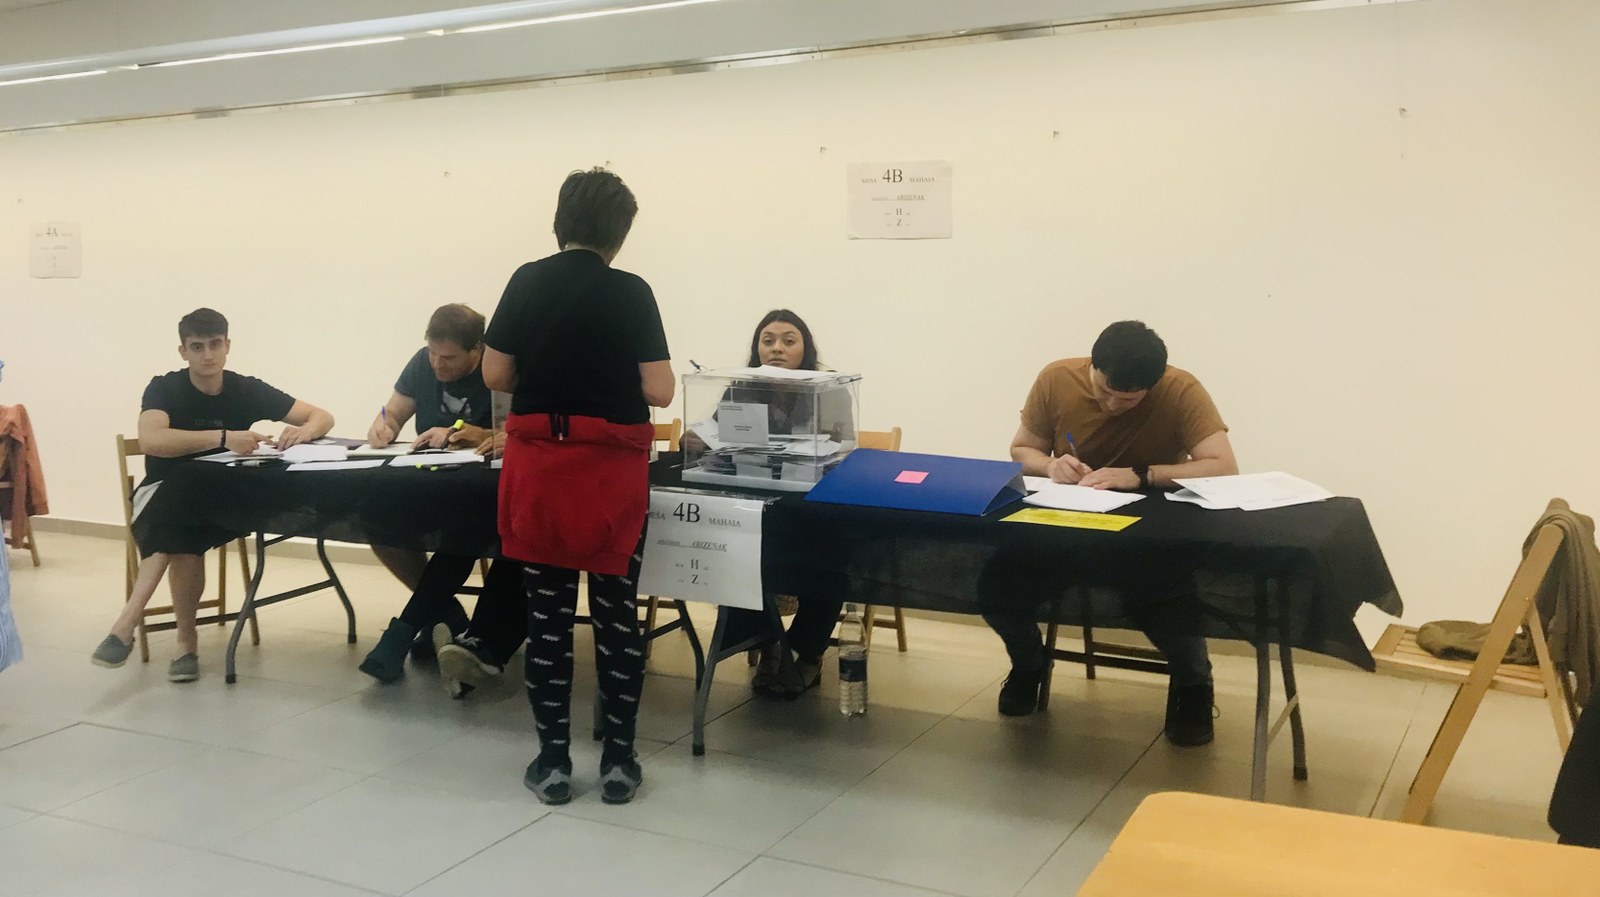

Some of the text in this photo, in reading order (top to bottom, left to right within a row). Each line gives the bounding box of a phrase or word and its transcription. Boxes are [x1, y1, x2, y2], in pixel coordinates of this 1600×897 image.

[882, 168, 903, 183] 4B
[673, 502, 700, 523] 4B
[708, 517, 741, 528] MAHAIA
[691, 574, 700, 585] Z
